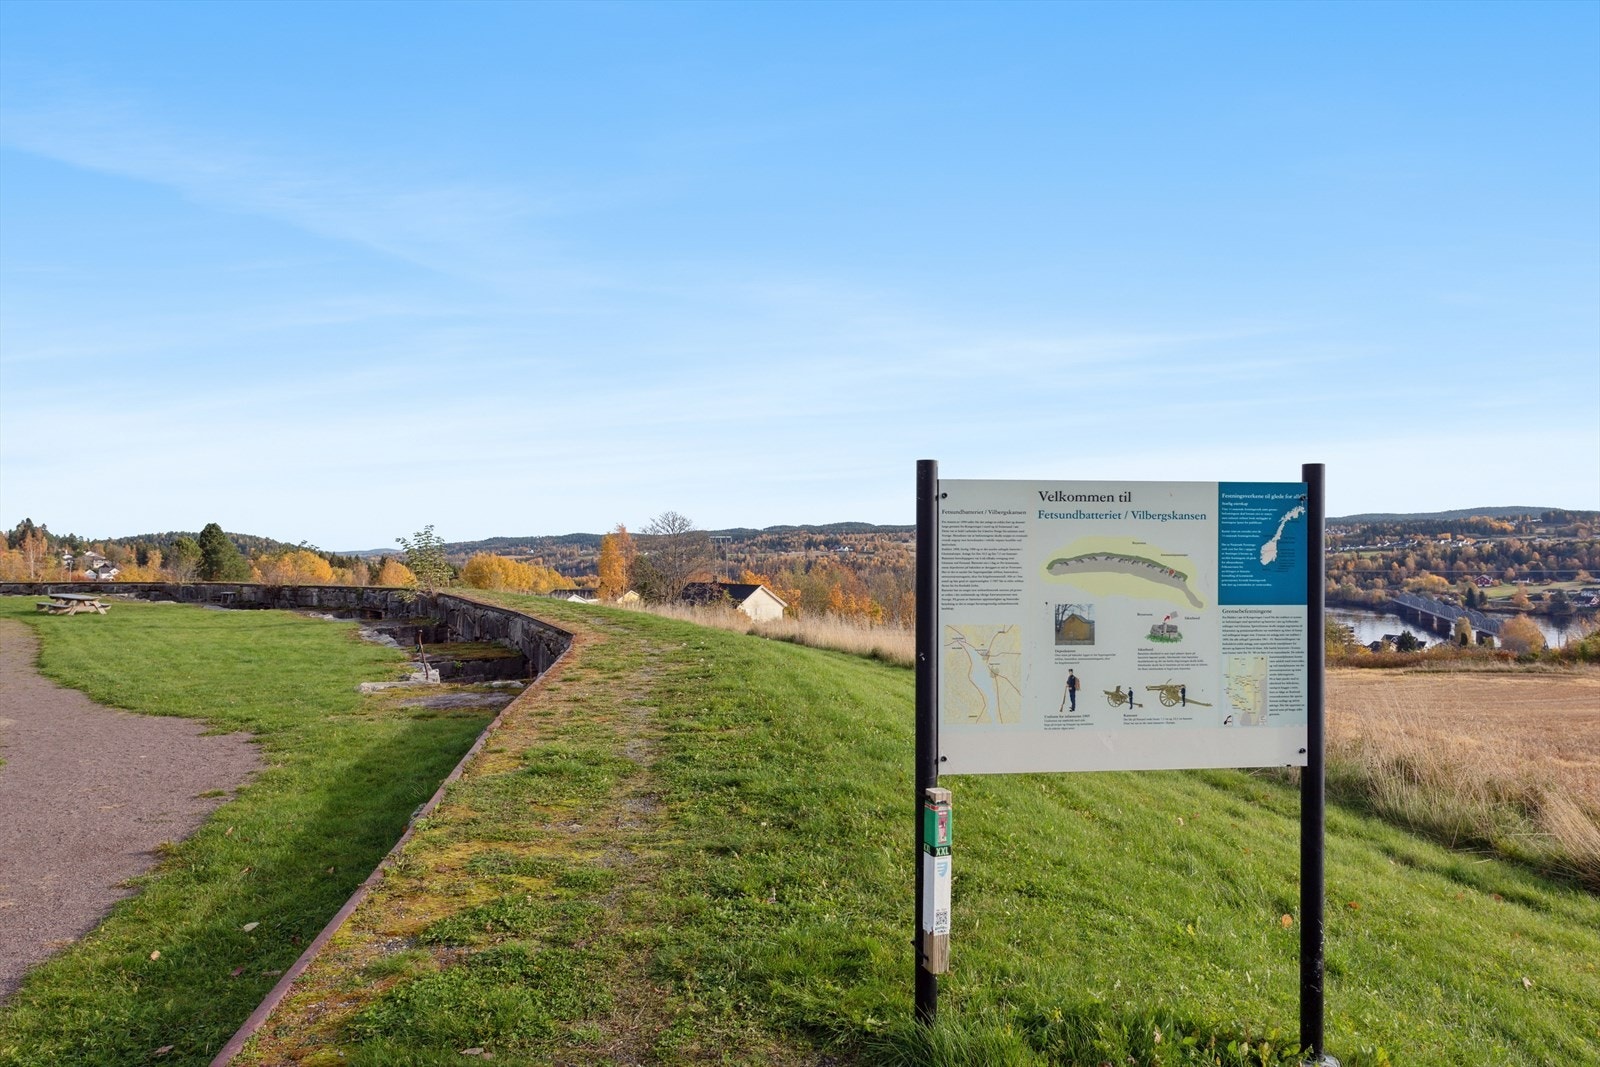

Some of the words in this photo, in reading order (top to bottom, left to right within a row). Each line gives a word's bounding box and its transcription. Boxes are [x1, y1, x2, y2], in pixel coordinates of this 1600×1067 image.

[1038, 490, 1115, 503] Velkommen
[1119, 491, 1132, 503] til
[1037, 509, 1122, 521] Fetsundbatteriet
[1124, 509, 1129, 521] /
[1131, 510, 1207, 522] Vilbergskansen
[936, 847, 950, 856] XXL
